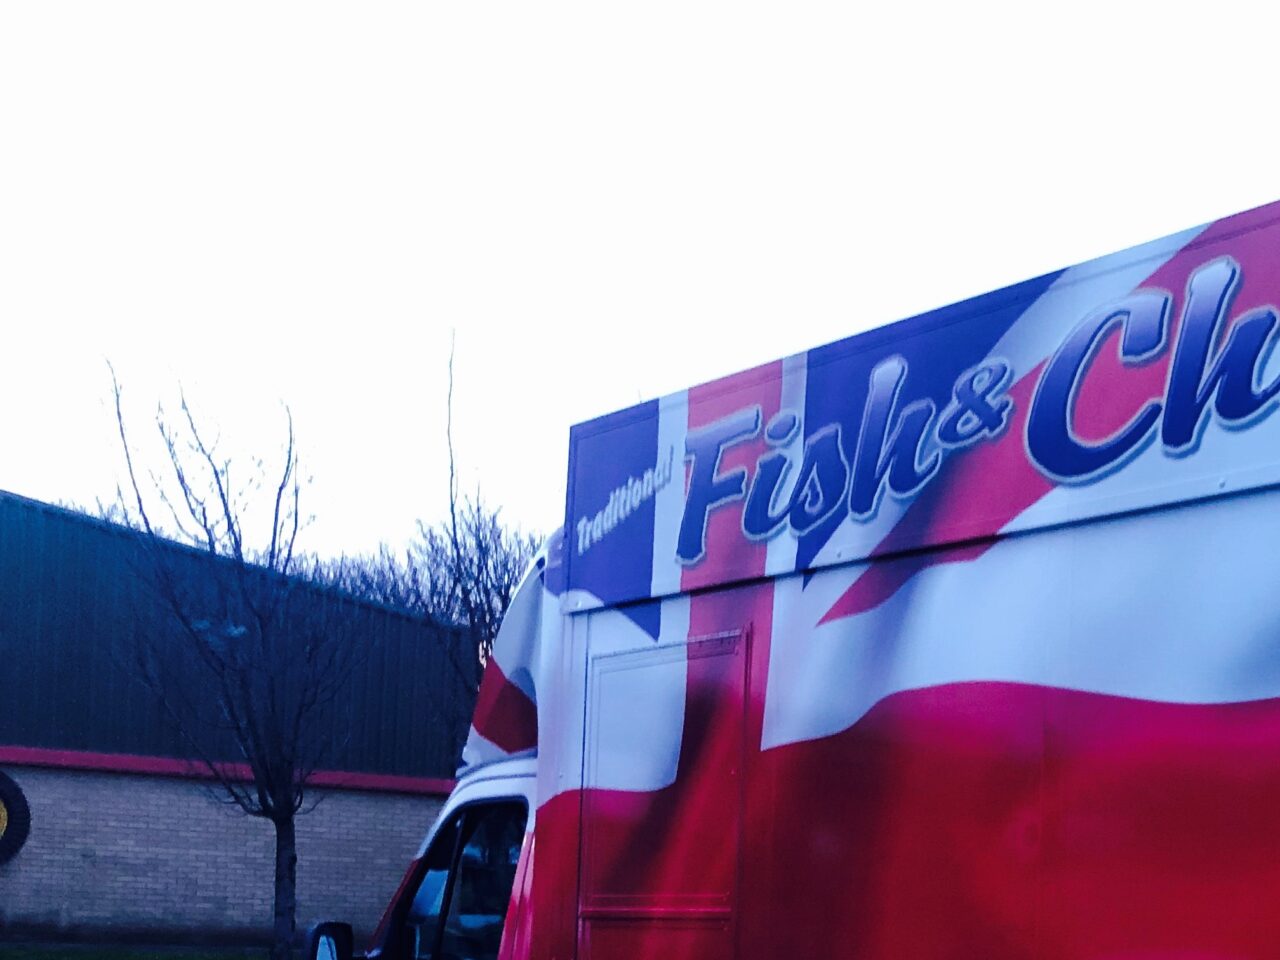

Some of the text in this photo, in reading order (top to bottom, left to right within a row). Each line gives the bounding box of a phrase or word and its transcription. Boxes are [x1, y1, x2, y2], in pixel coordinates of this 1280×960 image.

[577, 444, 674, 556] Traditional
[676, 354, 942, 564] Fish
[937, 357, 1016, 448] &
